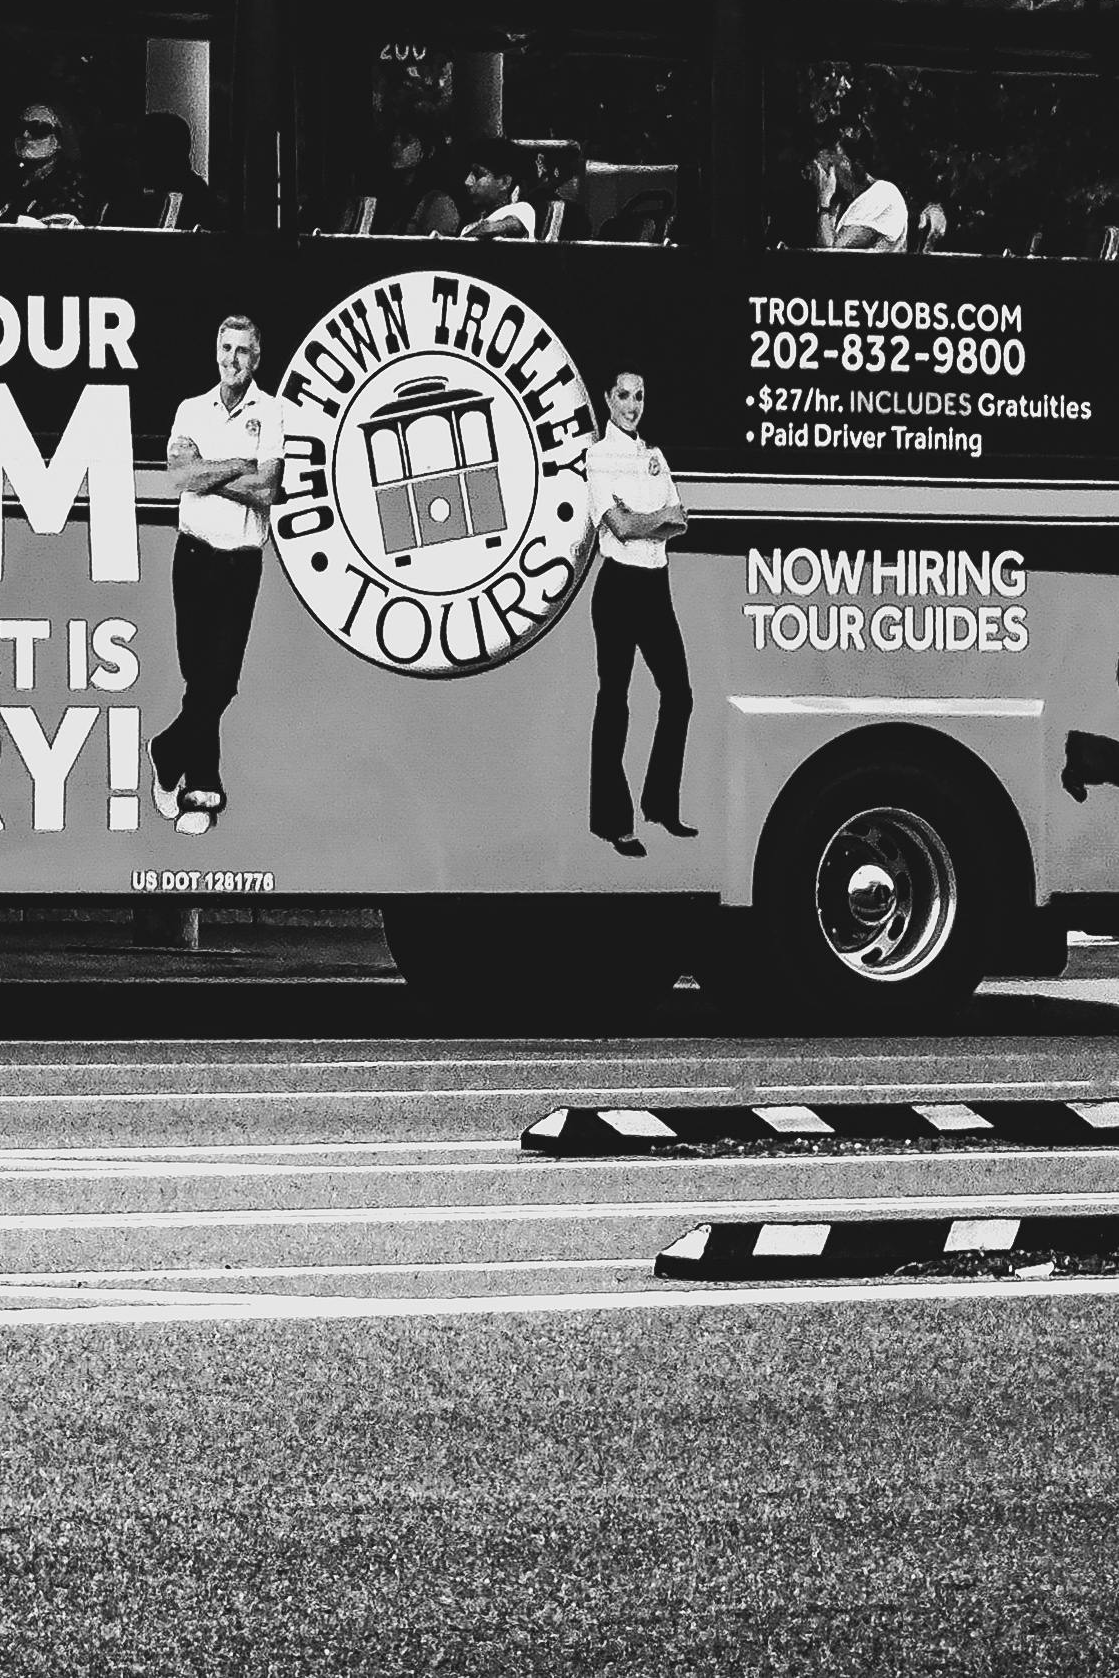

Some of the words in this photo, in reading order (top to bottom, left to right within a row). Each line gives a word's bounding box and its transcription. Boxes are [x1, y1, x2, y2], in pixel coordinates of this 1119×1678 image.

[748, 296, 1023, 335] TROLLEYJOBS.COM
[281, 282, 411, 419] TOWN
[749, 329, 1027, 376] 202-832-9800
[432, 275, 597, 483] TROLLEY
[757, 383, 845, 414] $27/hr.
[849, 389, 973, 418] INCLUDES
[977, 392, 1093, 420] Gratuities
[760, 421, 809, 448] Paid
[813, 422, 887, 449] Driver
[889, 424, 983, 458] Training
[276, 433, 335, 541] OLD
[747, 546, 867, 597] NOW
[871, 548, 1027, 598] HIRING
[337, 534, 576, 667] TOURS
[742, 603, 867, 652] TOUR
[869, 605, 1029, 653] GUIDES
[68, 618, 140, 692] IS
[131, 870, 159, 892] US
[161, 870, 202, 891] DOT
